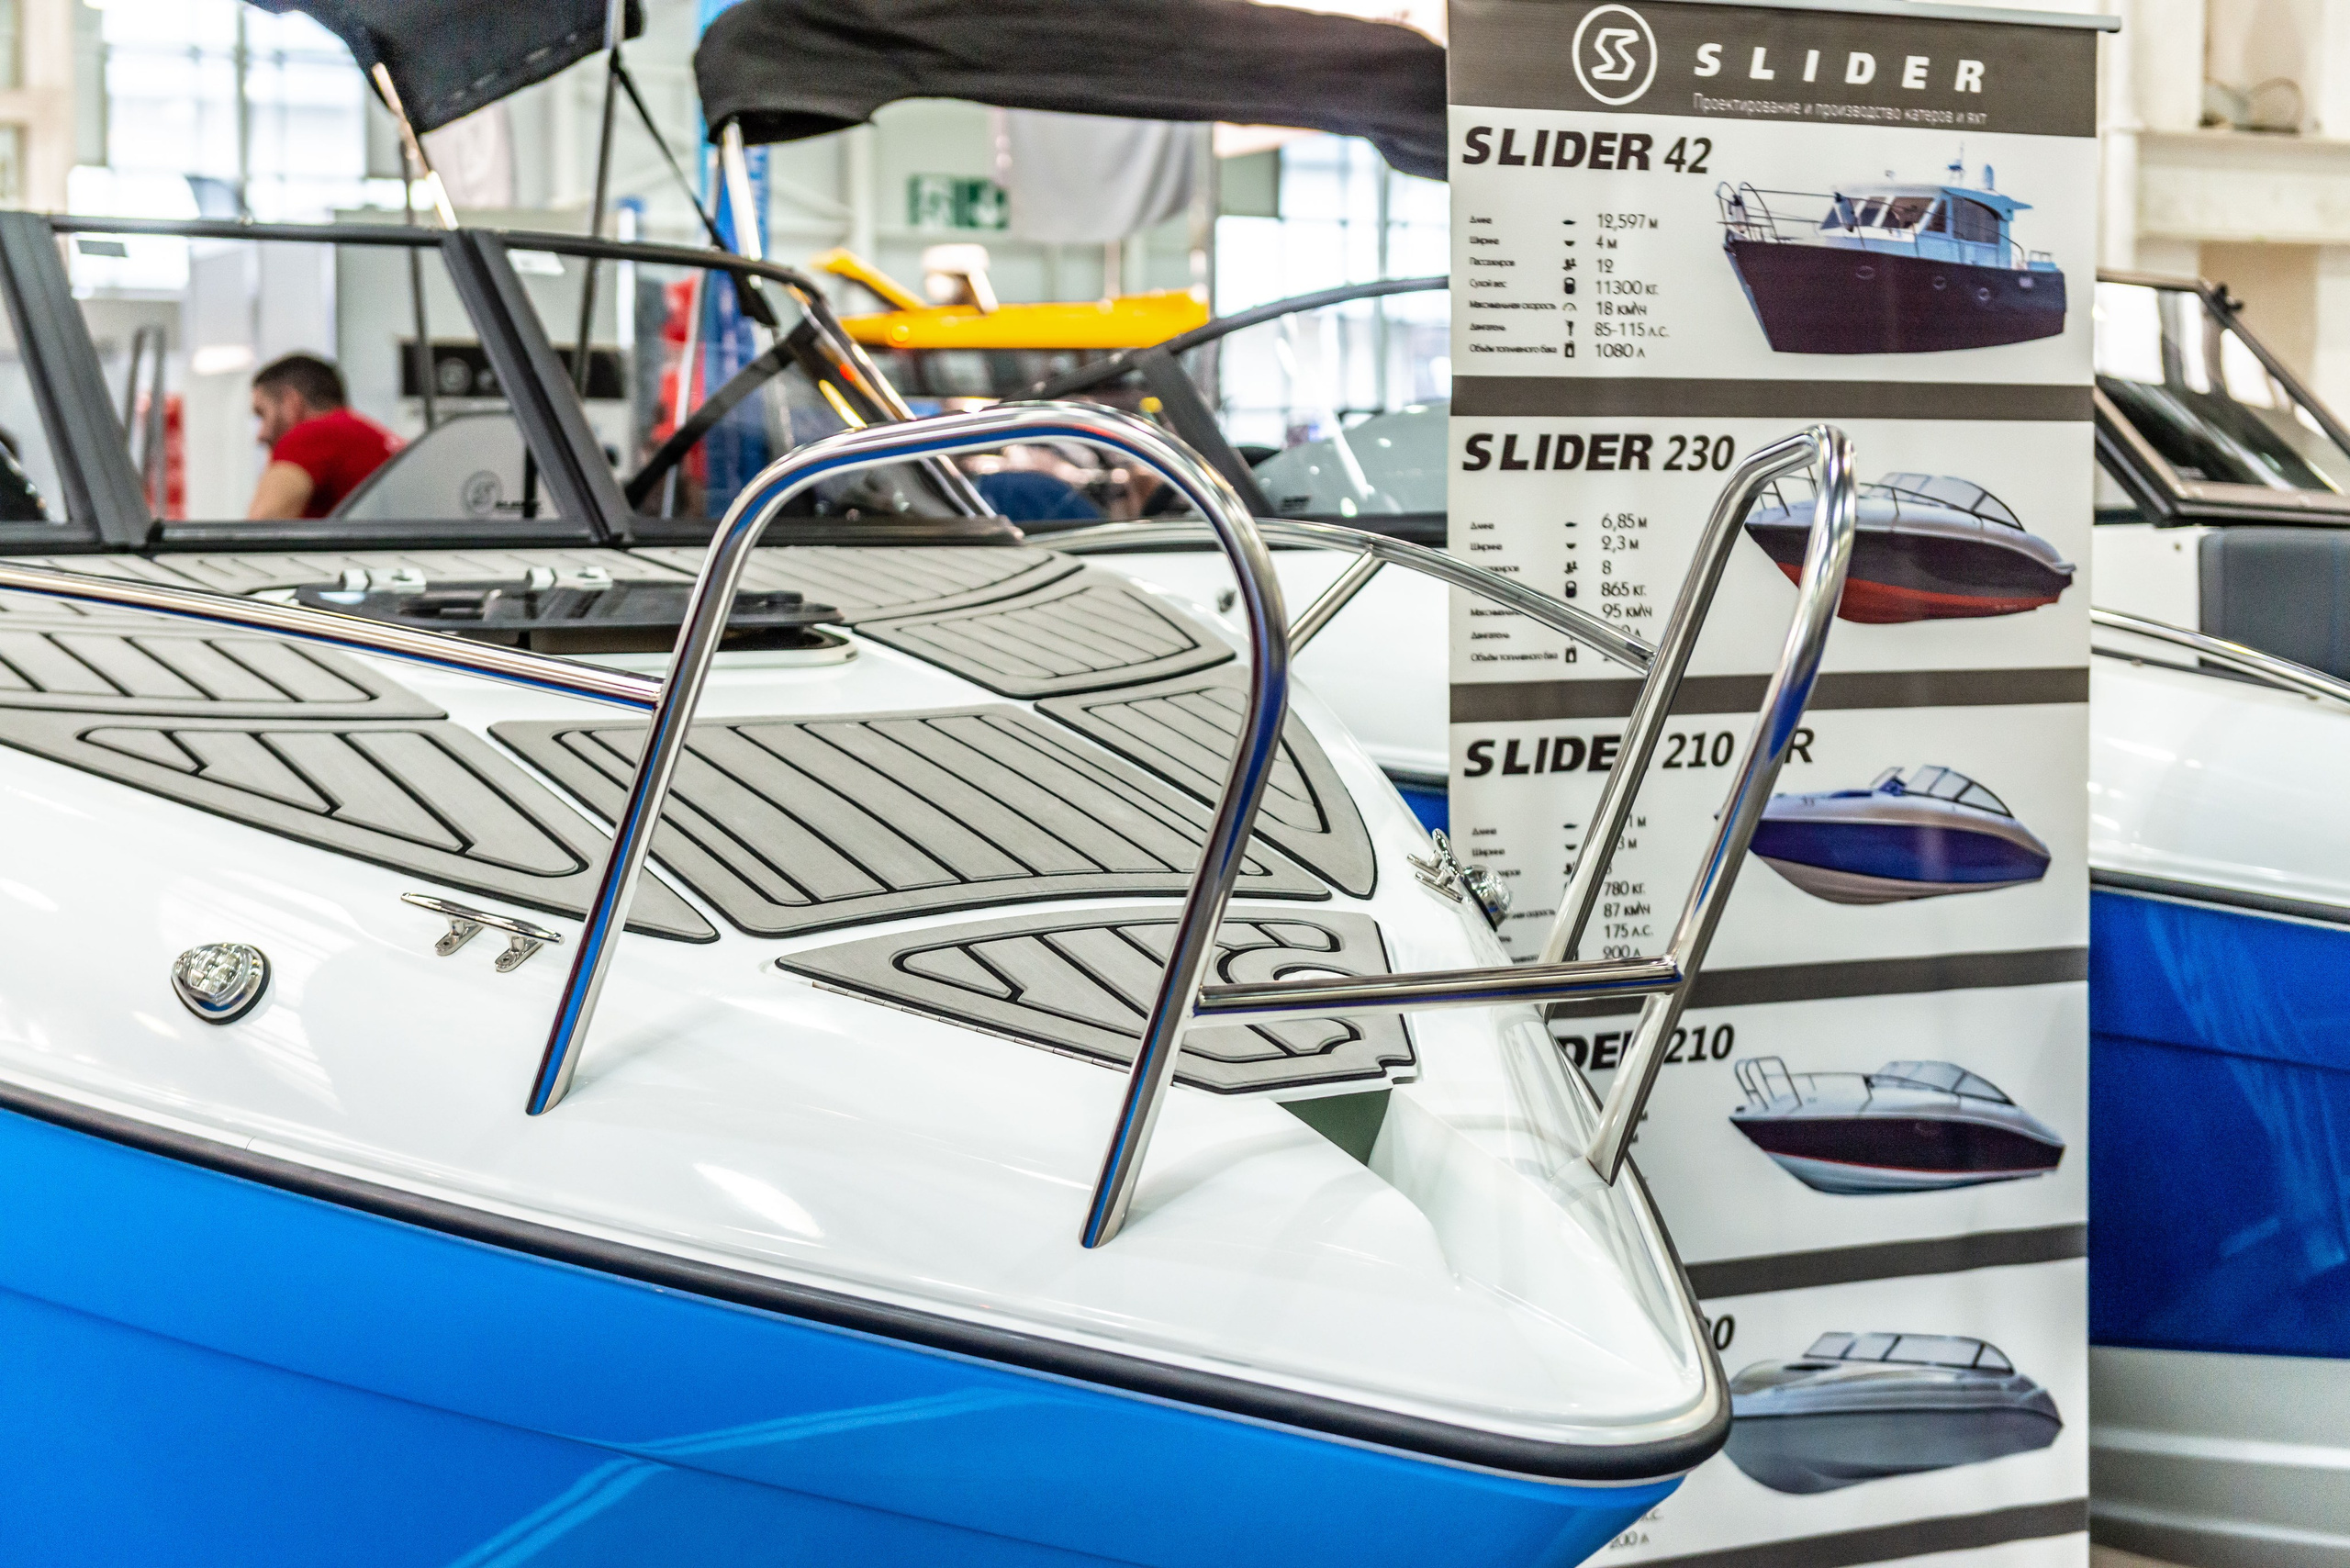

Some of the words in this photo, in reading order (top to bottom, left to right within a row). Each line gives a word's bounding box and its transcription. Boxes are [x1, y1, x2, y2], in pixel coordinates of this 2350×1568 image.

[1694, 42, 1986, 93] SLIDER
[1694, 93, 1801, 117] Проектирование
[1804, 103, 1813, 115] и
[1815, 103, 1901, 120] производство
[1904, 108, 1953, 125] катеров
[1956, 112, 1965, 123] и
[1967, 112, 1987, 124] яхт
[1462, 126, 1653, 171] SLIDER
[1663, 137, 1712, 174] 42
[1597, 213, 1646, 231] 12,597
[1595, 235, 1604, 249] 4
[1596, 258, 1614, 274] 12
[1595, 280, 1642, 295] 11300
[1596, 301, 1613, 316] 18
[1595, 322, 1645, 337] 85-115
[1595, 343, 1634, 358] 1080
[1462, 432, 1653, 471] SLIDER
[1663, 434, 1735, 472] 230
[1601, 513, 1635, 532] 6,85
[1601, 535, 1626, 554] 2,3
[1602, 560, 1612, 575] 8
[1601, 581, 1629, 597] 865
[1602, 603, 1622, 619] 95
[1464, 734, 1622, 778] SLIDE
[1662, 731, 1734, 769] 210
[1785, 727, 1815, 764] R
[1605, 880, 1629, 896] 780
[1604, 902, 1620, 917] 87
[1605, 924, 1629, 939] 175
[1662, 1023, 1735, 1065] 210
